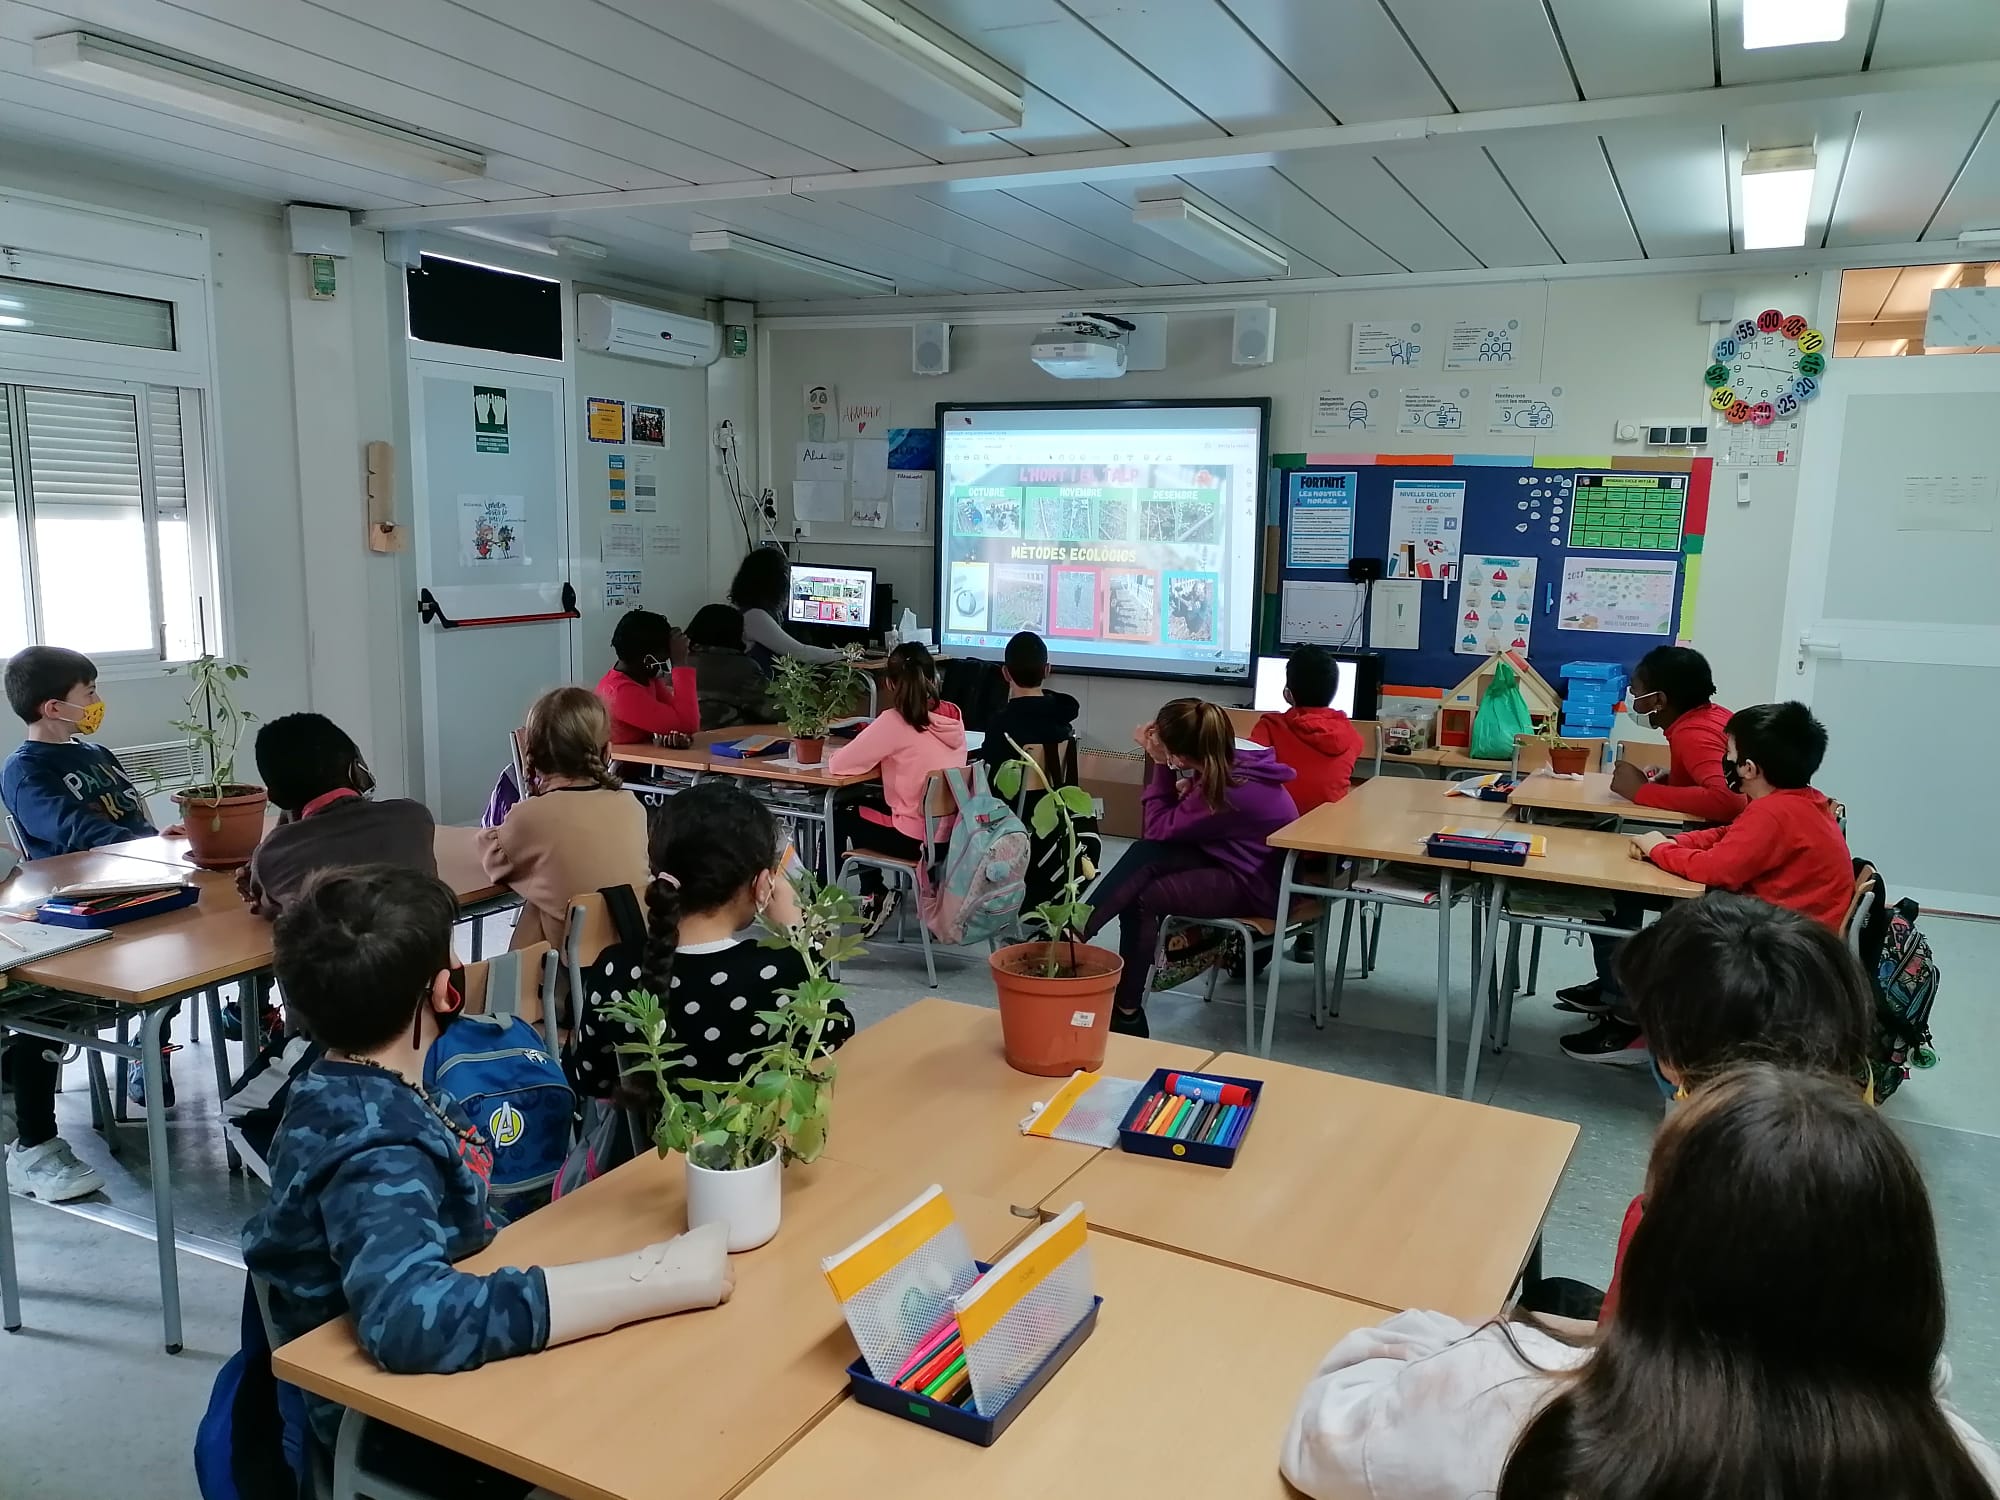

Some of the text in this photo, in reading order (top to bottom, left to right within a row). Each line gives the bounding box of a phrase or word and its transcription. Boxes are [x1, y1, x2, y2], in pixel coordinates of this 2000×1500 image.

[1761, 337, 1774, 345] 12
[1779, 340, 1785, 348] 1
[1750, 342, 1758, 350] 11
[1738, 351, 1751, 360] 10
[1788, 348, 1796, 357] 2
[1733, 365, 1741, 373] 9
[1792, 361, 1800, 369] 3
[1737, 378, 1744, 386] 8
[1776, 385, 1783, 393] 5
[1300, 475, 1346, 489] FORTNITE
[969, 487, 1005, 497] OCTUBRE
[1059, 487, 1102, 497] NOVEMBRE
[1153, 489, 1198, 500] DESEMBRE
[1010, 542, 1066, 560] MÈTODES
